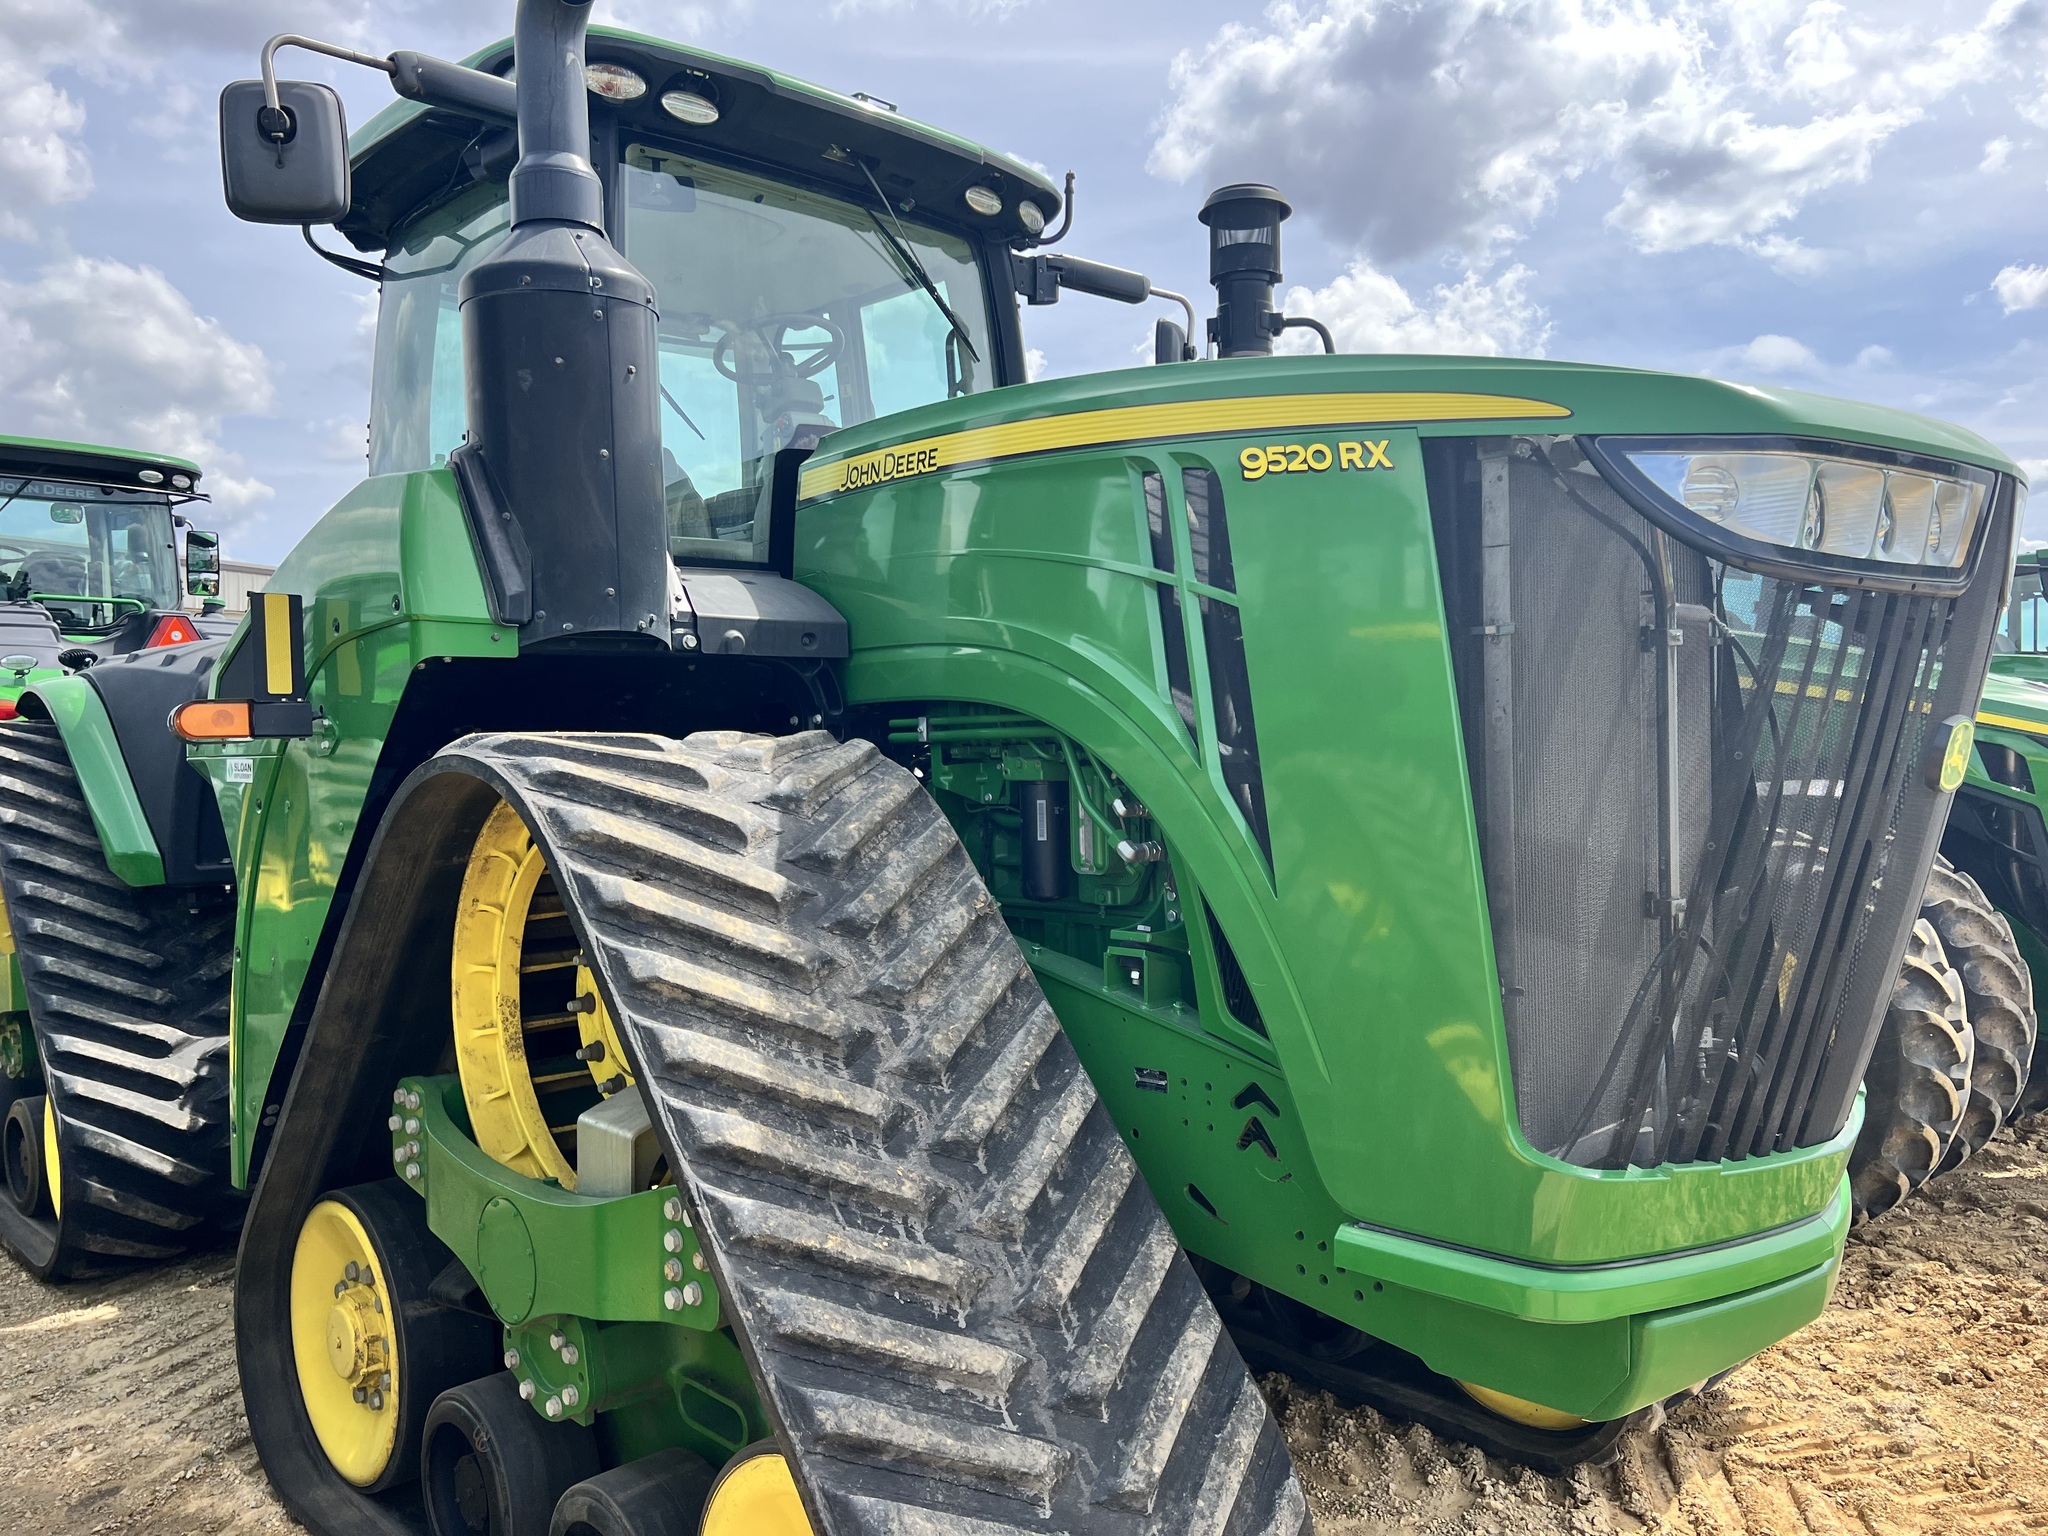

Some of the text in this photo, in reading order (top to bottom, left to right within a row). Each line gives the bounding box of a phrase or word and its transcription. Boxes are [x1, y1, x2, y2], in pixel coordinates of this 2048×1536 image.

[840, 448, 939, 491] JOHN DEERE
[1239, 439, 1395, 481] 9520 RX
[43, 484, 96, 499] DEERE
[233, 762, 252, 772] SLOAN
